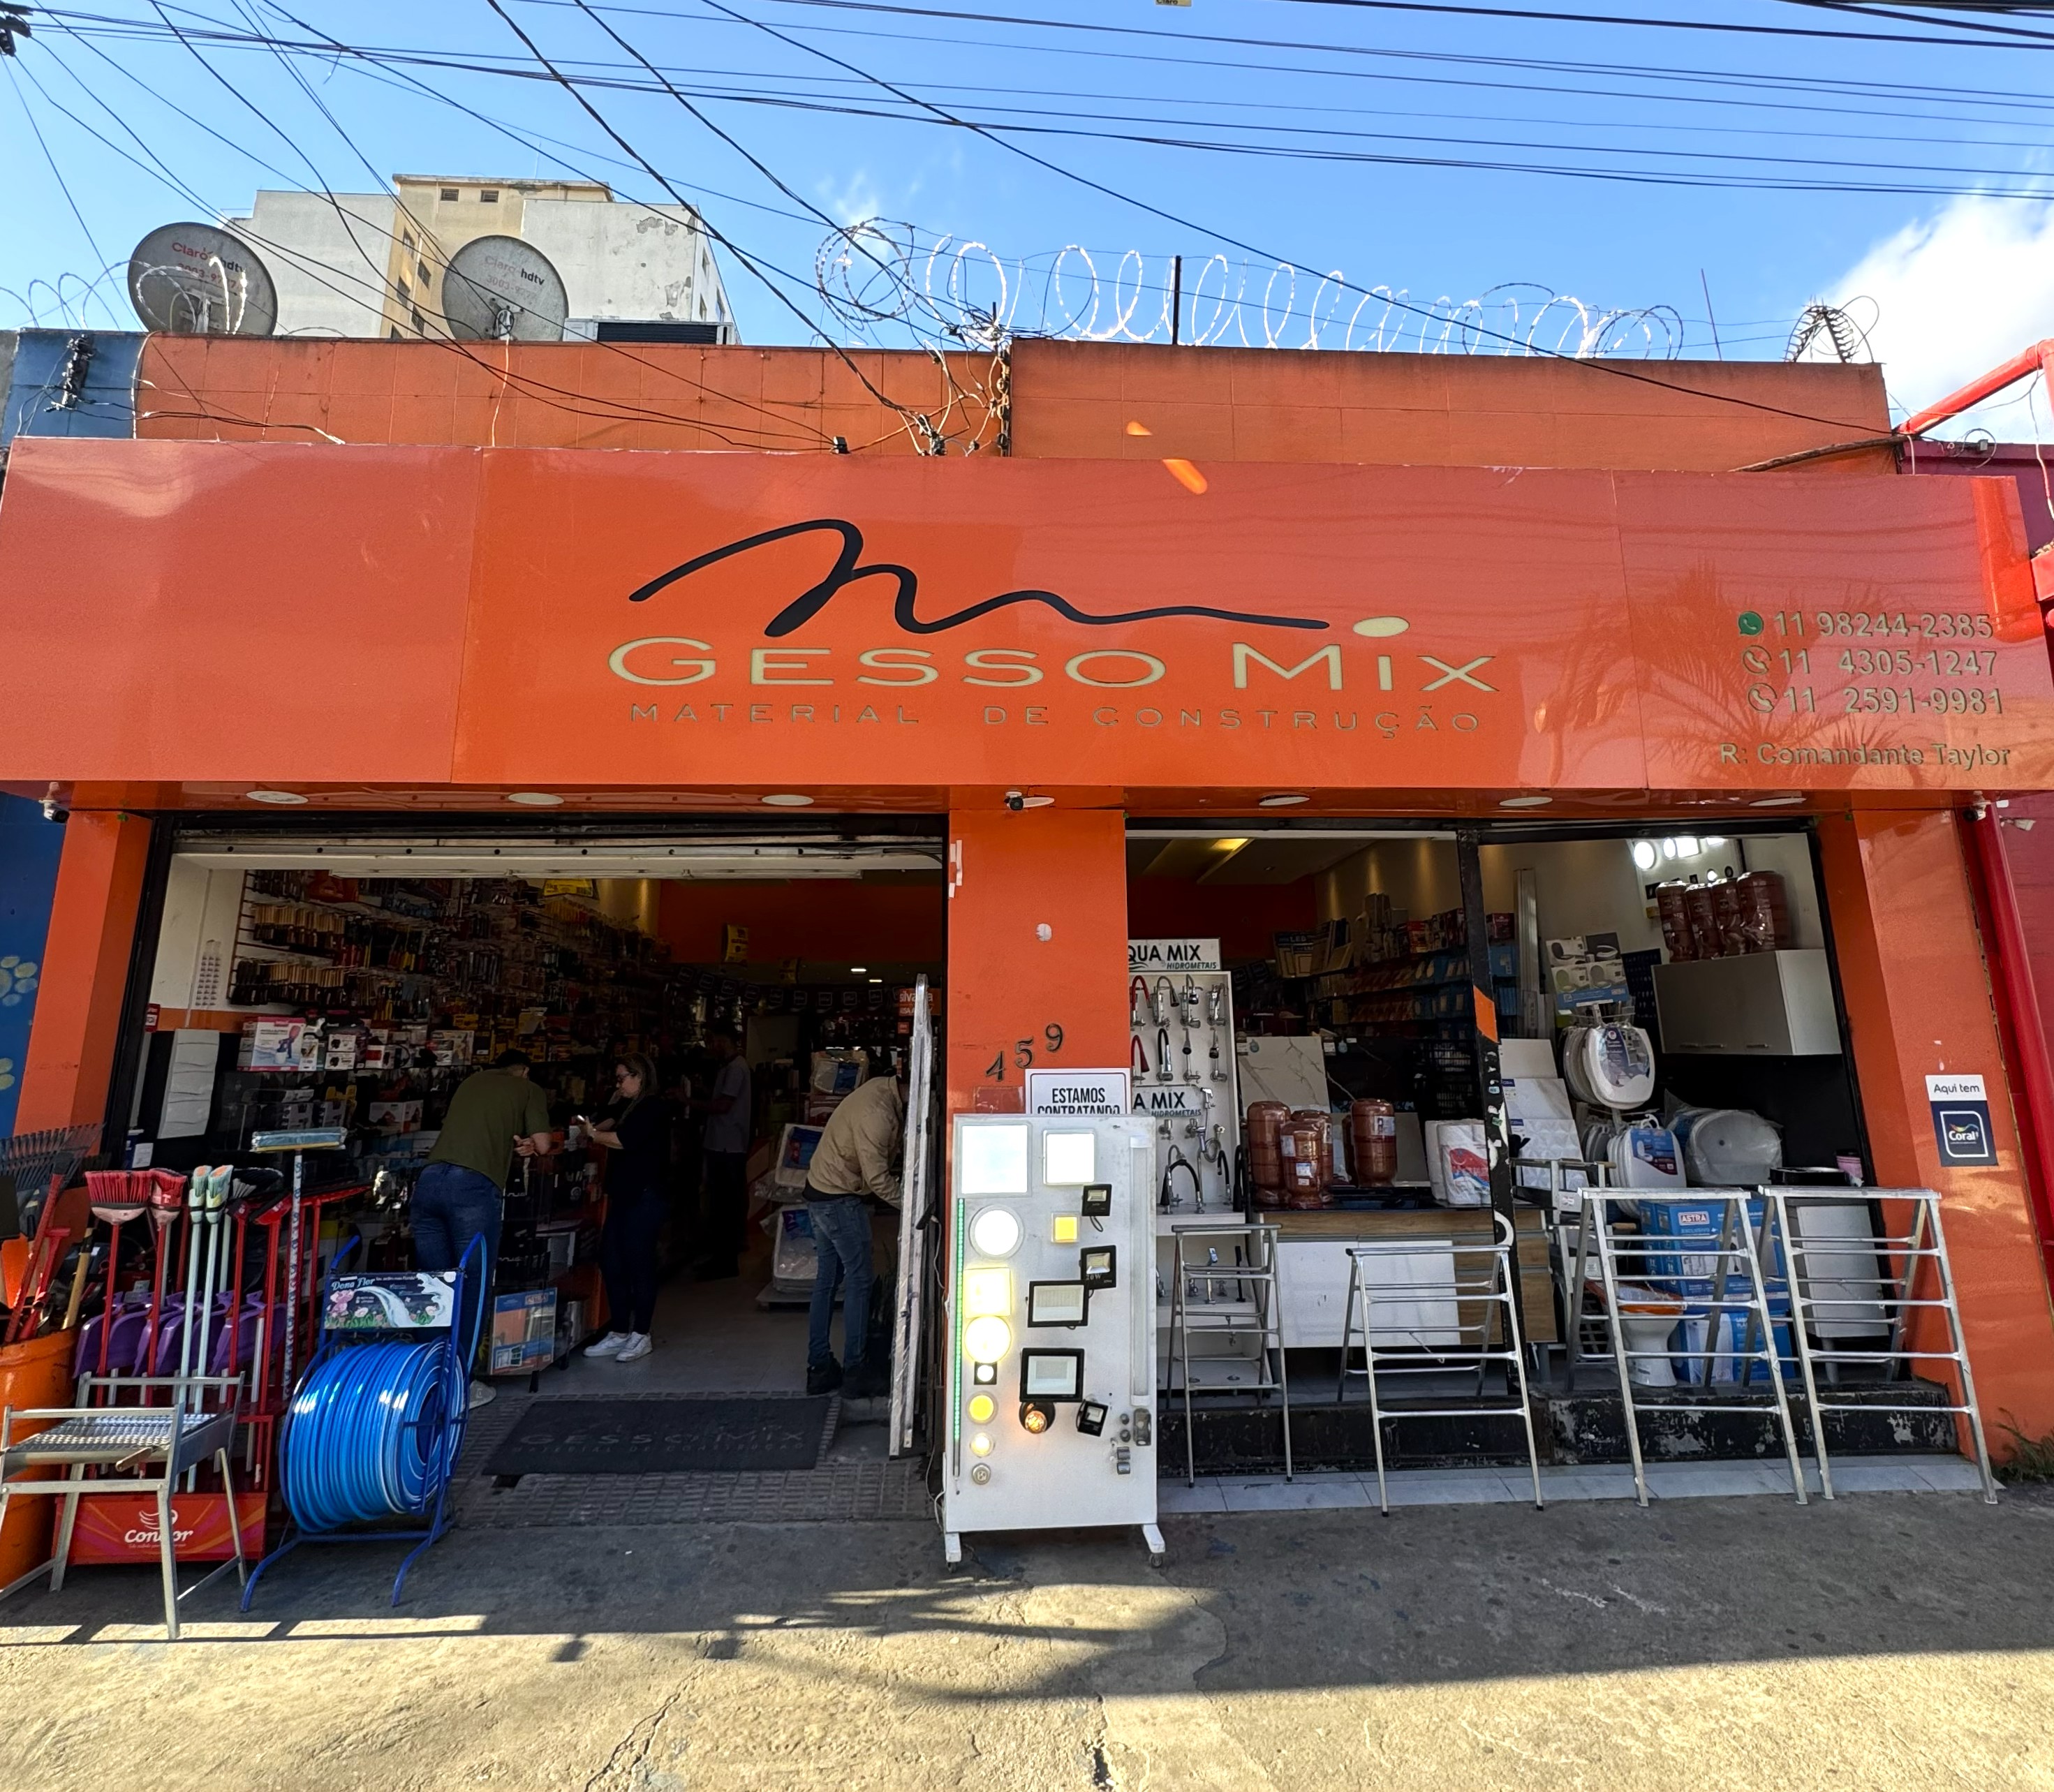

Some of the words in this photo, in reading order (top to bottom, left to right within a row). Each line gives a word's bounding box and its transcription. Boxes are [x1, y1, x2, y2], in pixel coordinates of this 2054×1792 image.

[171, 242, 208, 260] Claro
[520, 267, 545, 286] hdtv
[1774, 611, 1805, 637] 11
[1817, 611, 1994, 638] 98244-2385
[607, 635, 1167, 688] GESSO
[1780, 649, 1811, 674] 11
[1838, 649, 1997, 676] 4305-1247
[1784, 686, 1816, 713] 11
[1844, 686, 2003, 714] 2591-9981
[630, 703, 919, 723] MATERIAL
[983, 706, 1050, 725] DE
[1093, 705, 1480, 740] CONSTRUÇÃO
[1757, 743, 1924, 765] Comandante
[1930, 743, 2011, 771] Taylor
[1128, 945, 1162, 962] QUA
[1167, 945, 1202, 961] MIX
[1167, 961, 1217, 970] HIDROMETAIS
[1051, 1087, 1105, 1104] ESTAMOS
[1933, 1083, 1957, 1095] Aqui
[1959, 1083, 1980, 1093] tem
[1152, 1091, 1186, 1109] MIX
[1151, 1109, 1202, 1117] HIDROMETAIS
[1948, 1130, 1977, 1141] Coral
[1681, 1214, 1707, 1222] ASTRA
[331, 1280, 355, 1291] Dona
[356, 1277, 376, 1288] Flor
[124, 1530, 194, 1543] Conor
